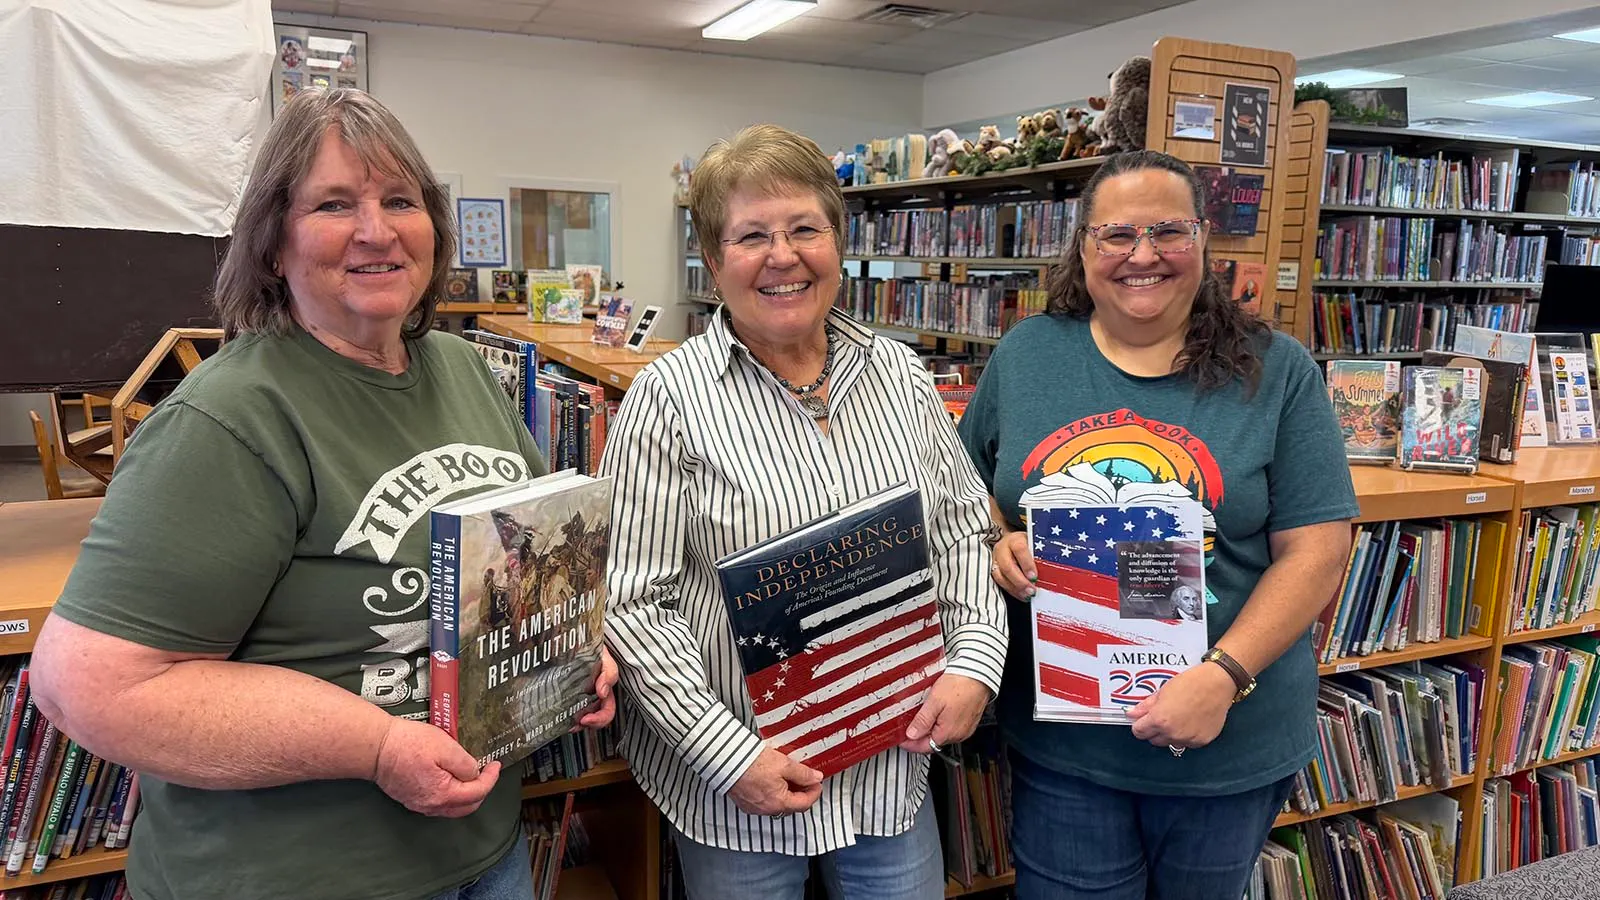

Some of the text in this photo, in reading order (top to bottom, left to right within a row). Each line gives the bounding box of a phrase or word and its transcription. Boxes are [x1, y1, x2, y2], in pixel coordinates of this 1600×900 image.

[1065, 413, 1117, 436] TAKE
[1123, 410, 1135, 421] A
[358, 462, 439, 540] THE
[434, 451, 534, 483] BOO
[734, 524, 923, 610] INDEPENDENCE
[757, 516, 899, 584] DECLARING
[1129, 575, 1142, 583] only
[1143, 575, 1170, 583] guardian
[431, 541, 443, 621] REVOLUTION
[443, 537, 456, 631] THE AMERICAN
[784, 567, 888, 615] of America's Founding Document
[795, 564, 876, 600] The Origin and Influence
[477, 588, 598, 660] THE AMERICAN
[487, 623, 587, 690] REVOLUTION
[1109, 652, 1189, 666] AMERICA
[433, 710, 443, 727] KEN
[442, 692, 451, 732] GEOFFREY
[477, 741, 515, 769] GEOFFREY
[525, 724, 544, 742] WARD
[554, 711, 567, 725] KEN
[49, 758, 75, 823] BUFFALO FLUFFALO
